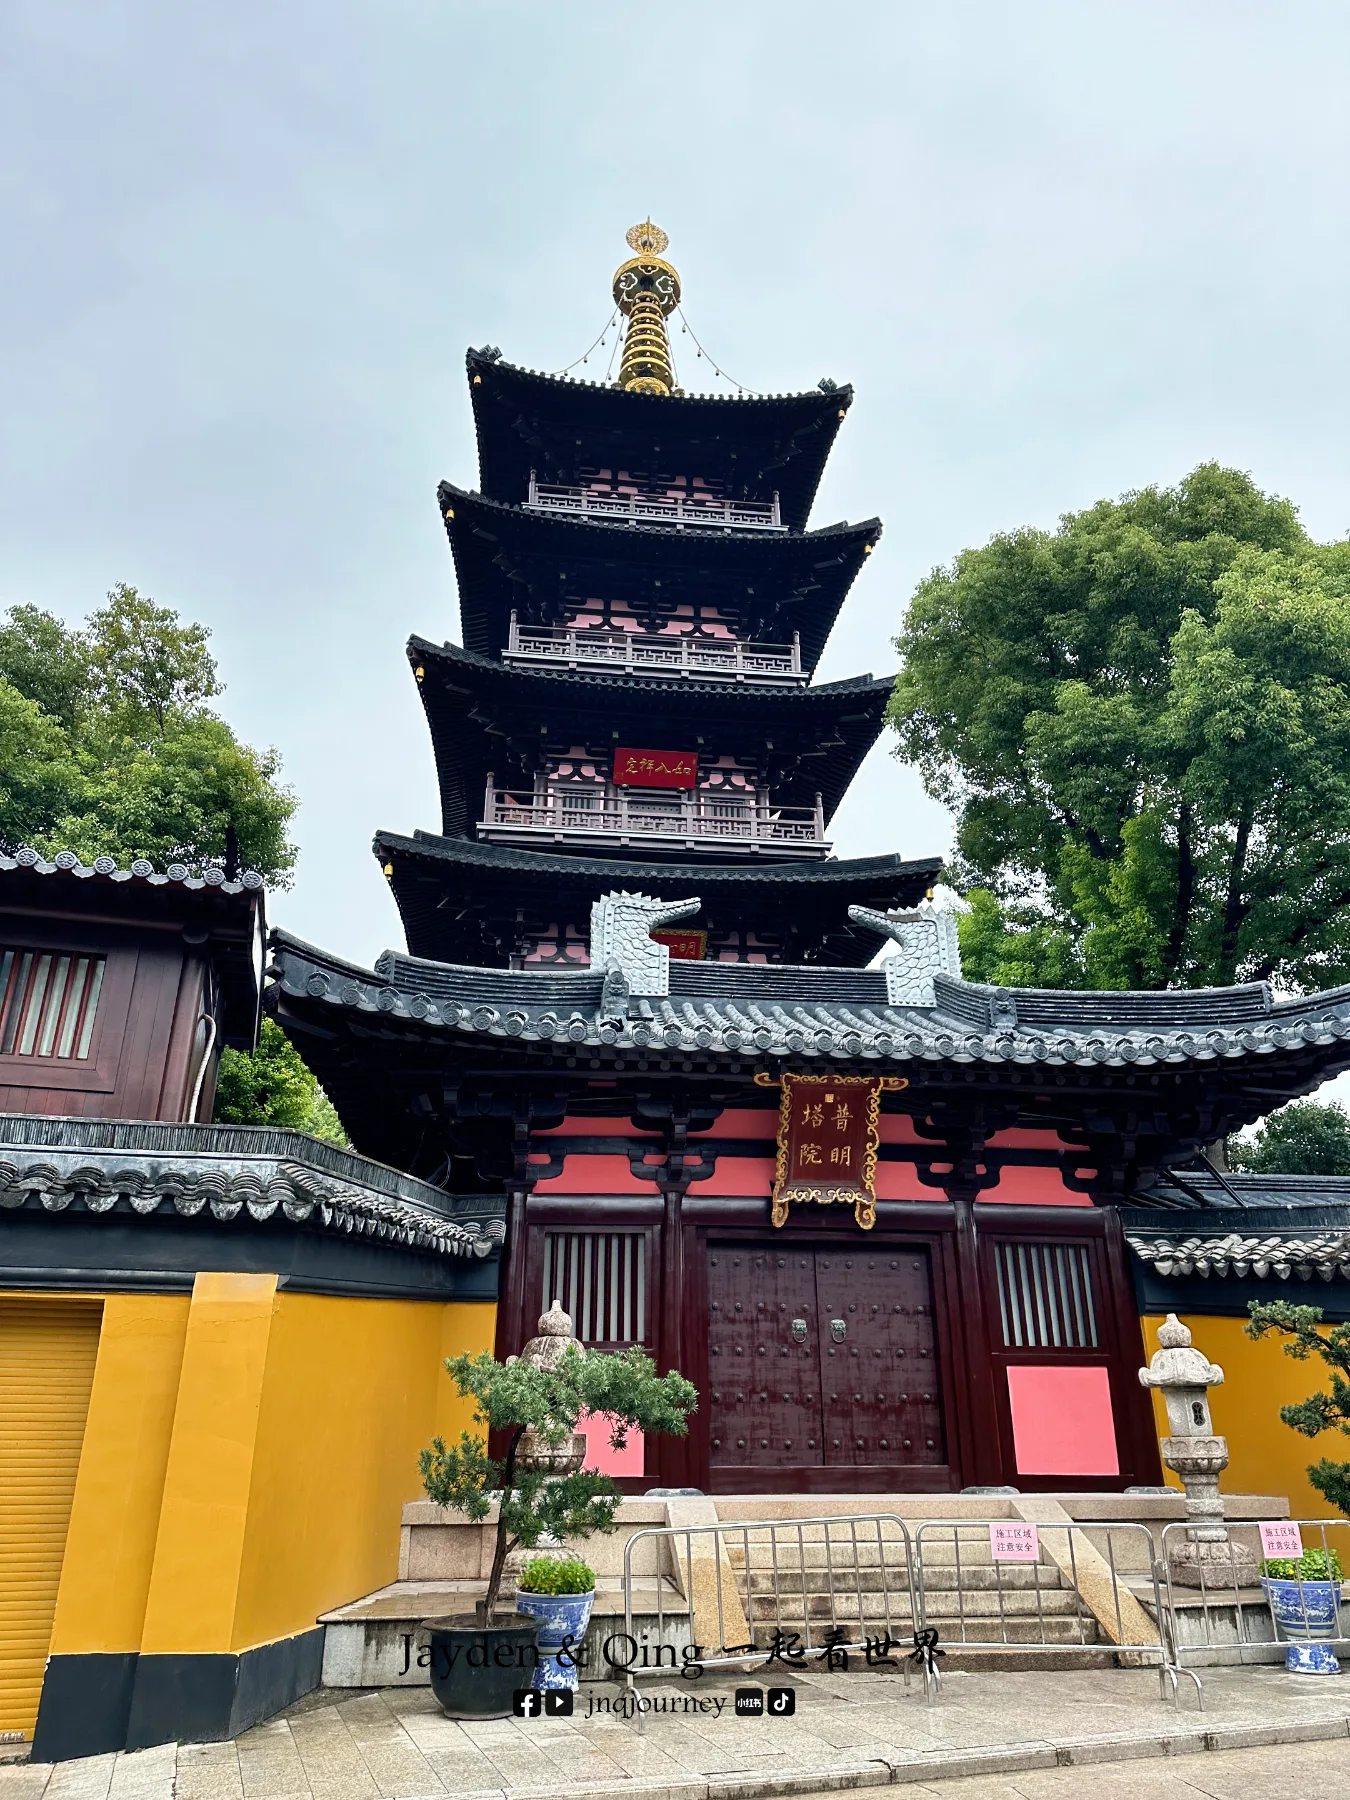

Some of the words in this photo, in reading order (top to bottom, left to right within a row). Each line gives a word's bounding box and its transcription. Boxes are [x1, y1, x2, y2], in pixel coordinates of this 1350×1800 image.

[995, 1528, 1032, 1539] 施工区域
[1265, 1527, 1297, 1537] 施工区域
[997, 1542, 1033, 1552] 注意安全
[1267, 1540, 1299, 1550] 注意安全
